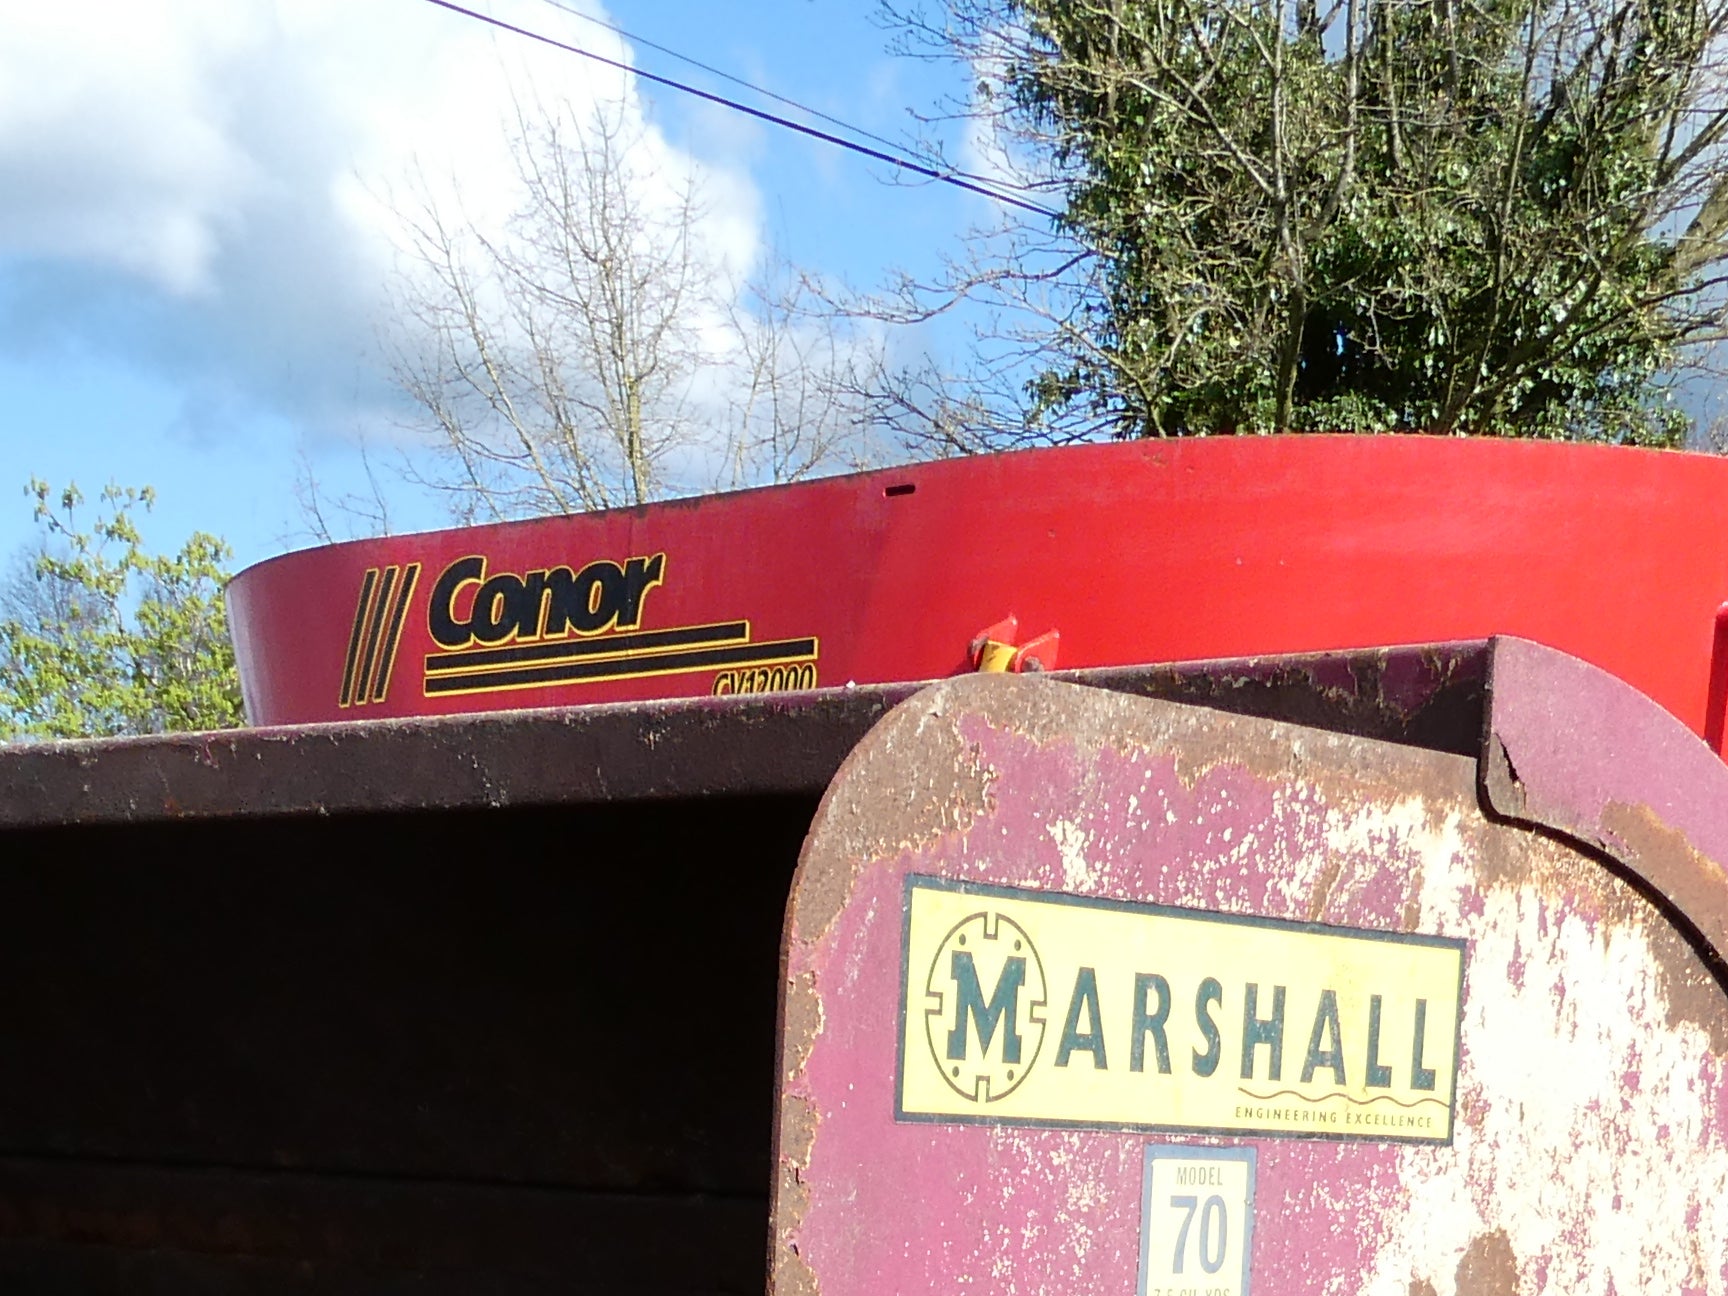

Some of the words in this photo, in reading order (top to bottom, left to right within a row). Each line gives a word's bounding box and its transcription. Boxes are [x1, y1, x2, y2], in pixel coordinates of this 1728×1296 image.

[427, 553, 666, 650] Conor
[945, 950, 1437, 1092] MARSHALL
[1235, 1106, 1337, 1124] ENGINEERING
[1346, 1112, 1432, 1128] EXCELLENCE
[1176, 1166, 1224, 1186] MODEL
[1169, 1194, 1228, 1275] 70
